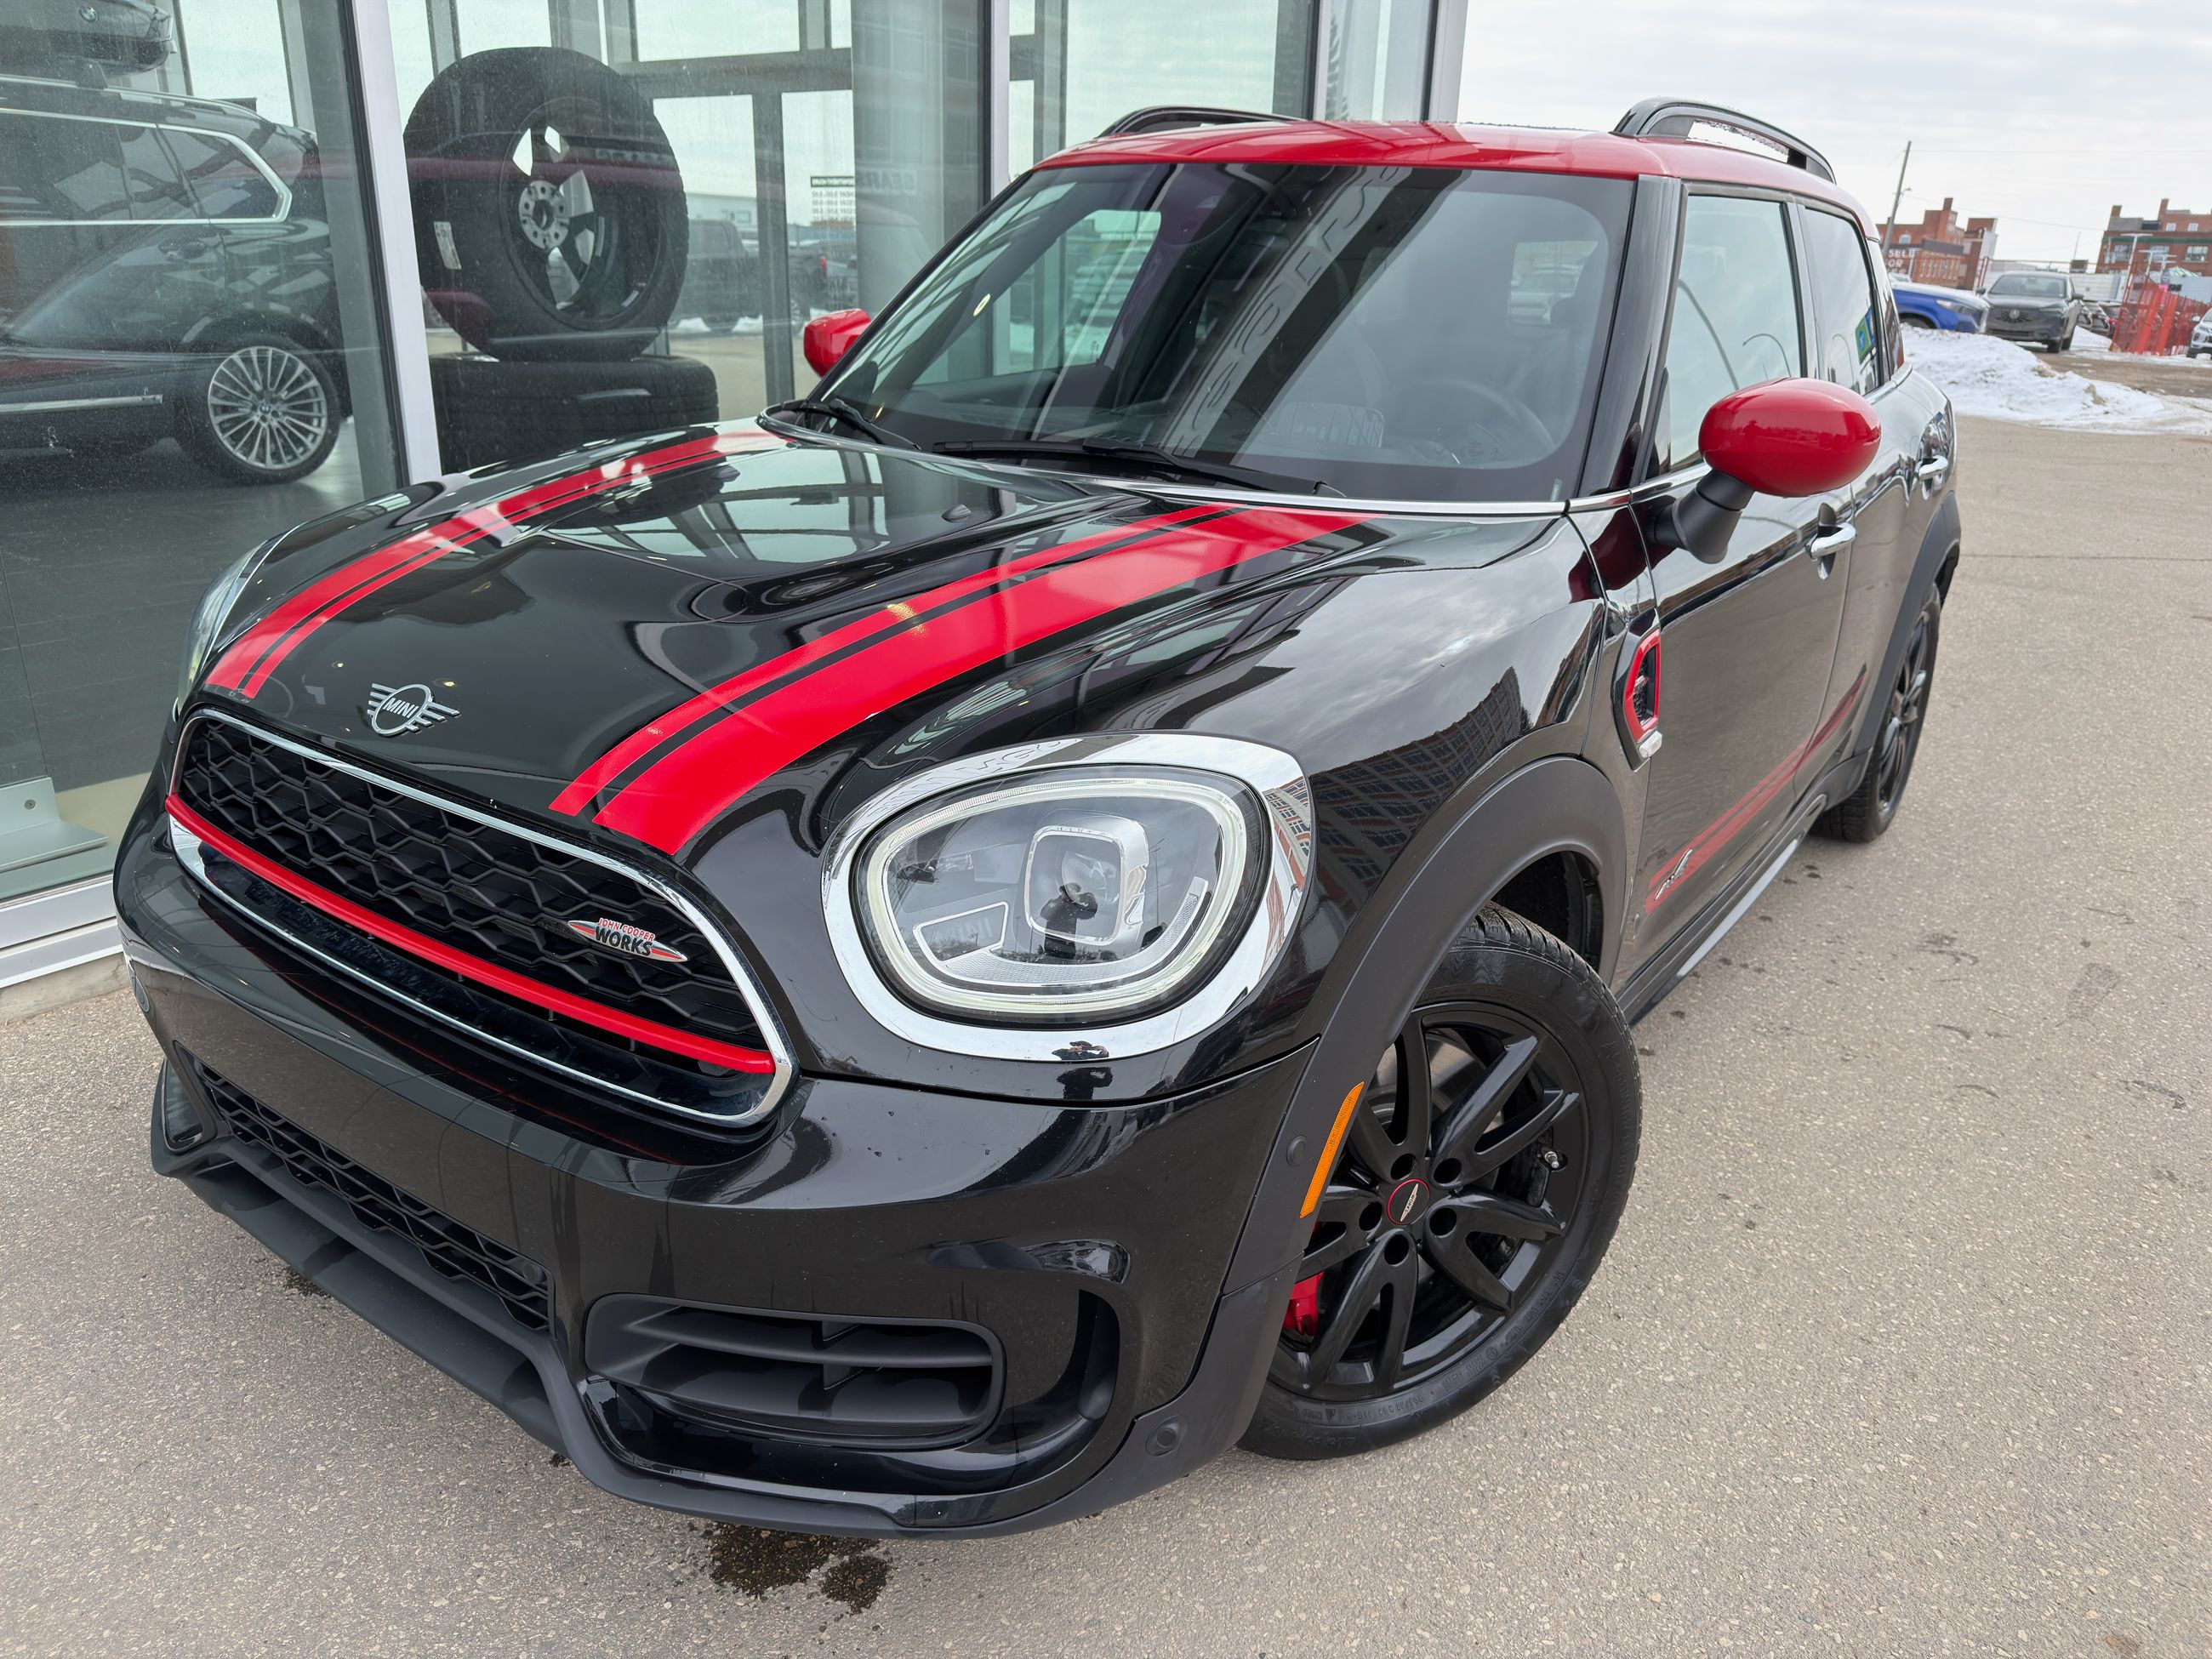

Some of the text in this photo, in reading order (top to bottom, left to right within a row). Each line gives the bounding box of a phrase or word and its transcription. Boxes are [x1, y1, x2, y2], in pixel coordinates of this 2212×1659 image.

[382, 698, 419, 719] MINI
[596, 918, 655, 942] JOHN COOPER
[596, 926, 653, 956] WORKS
